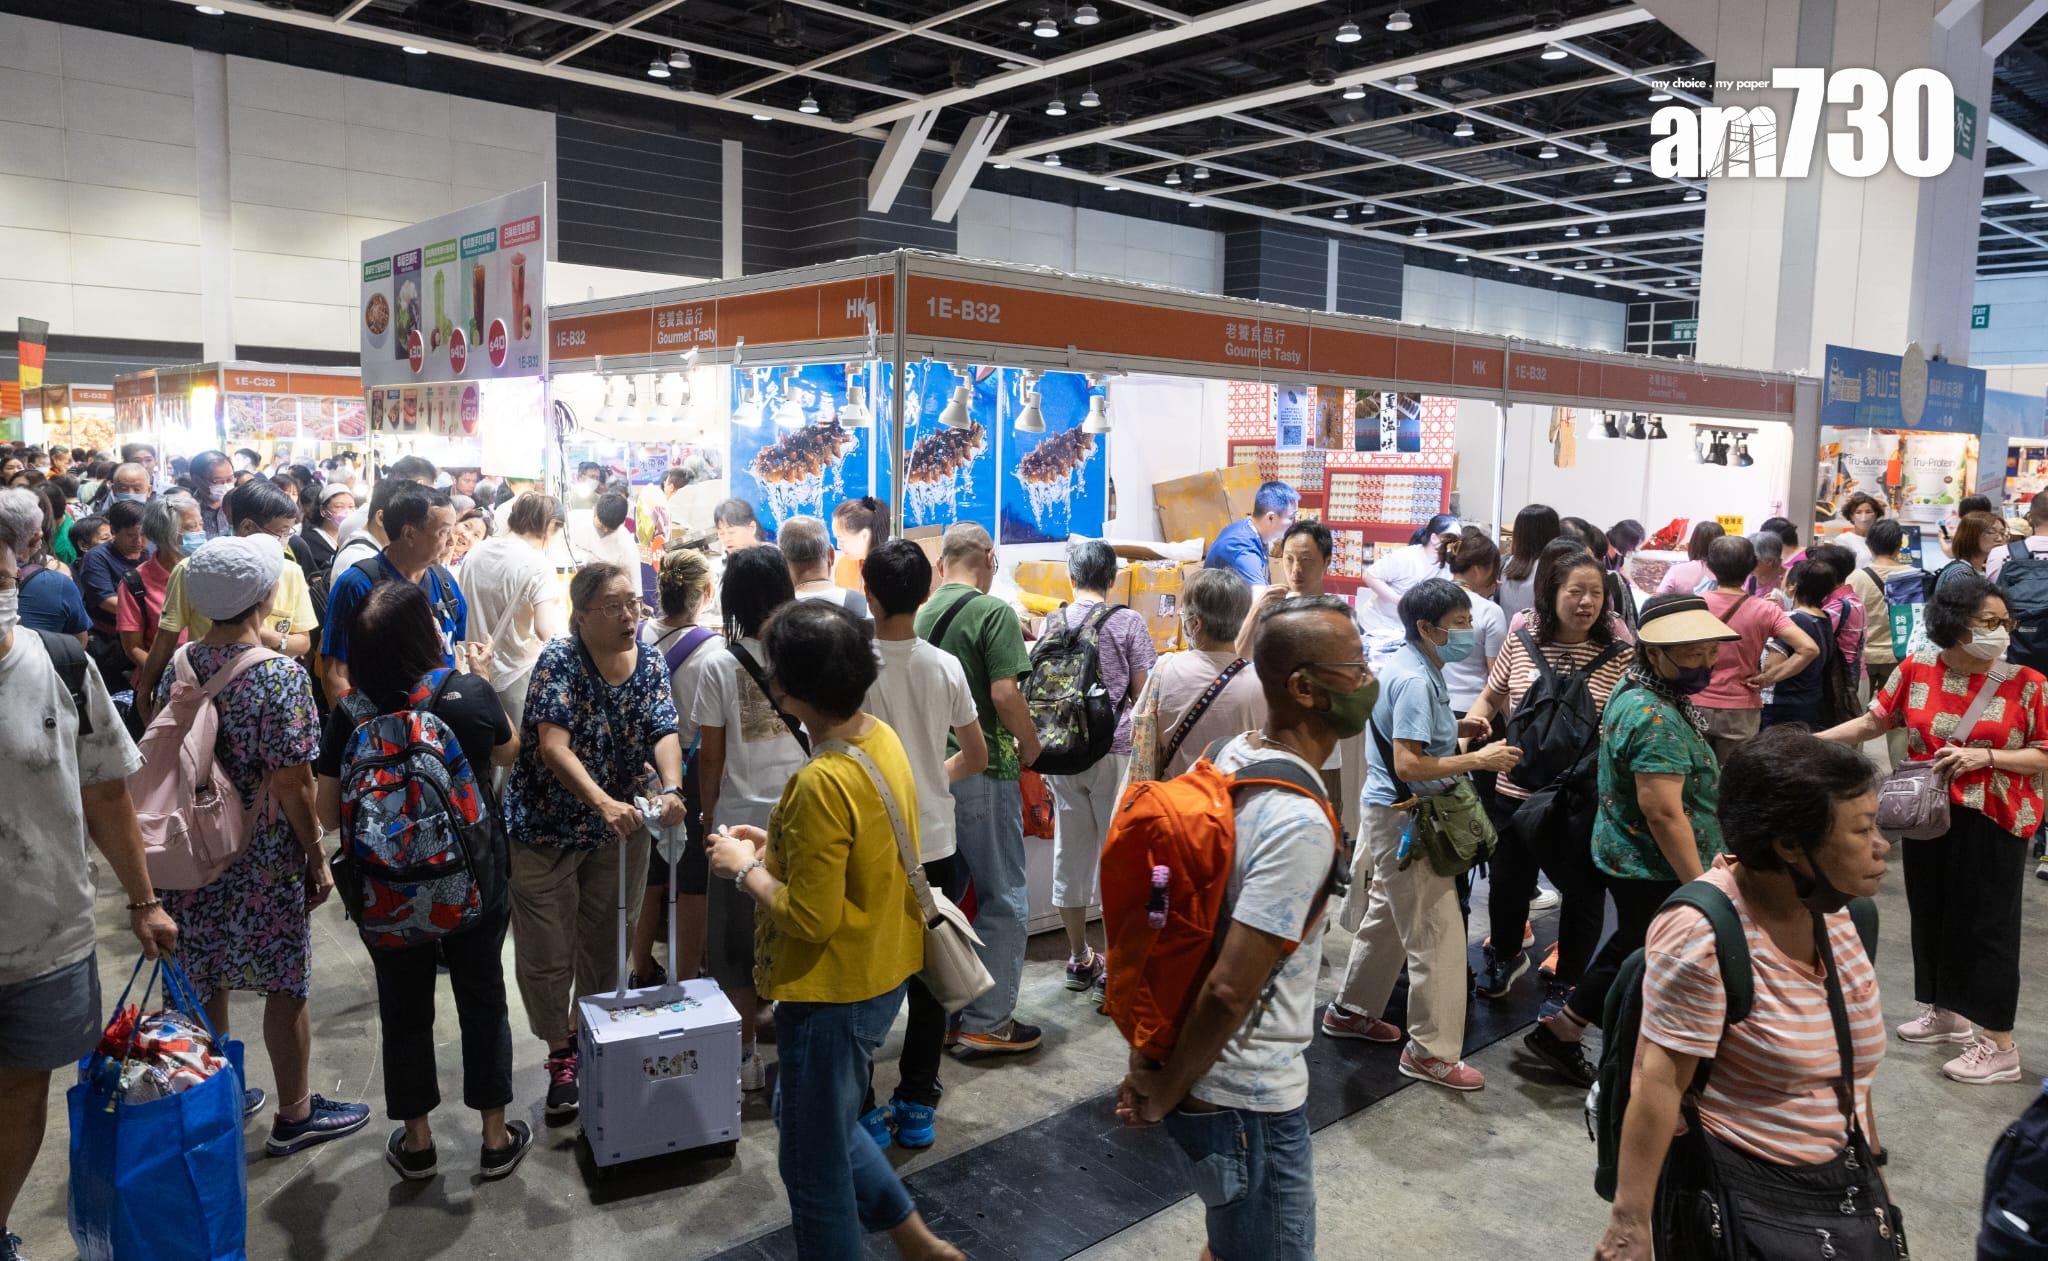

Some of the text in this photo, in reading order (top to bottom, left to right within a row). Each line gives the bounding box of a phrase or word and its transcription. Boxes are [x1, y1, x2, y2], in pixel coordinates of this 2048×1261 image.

[926, 295, 1000, 325] 1E-B32
[489, 335, 505, 352] $40
[556, 329, 586, 348] 1E-B32
[657, 327, 717, 345] Gourmet Tasty
[409, 346, 422, 359] $30
[450, 346, 465, 359] $40
[1225, 342, 1302, 365] Gourmet Tasty
[1471, 359, 1486, 375] HK
[1514, 363, 1547, 381] 1E-B32
[234, 377, 277, 388] 1E-C32
[461, 408, 477, 421] $60
